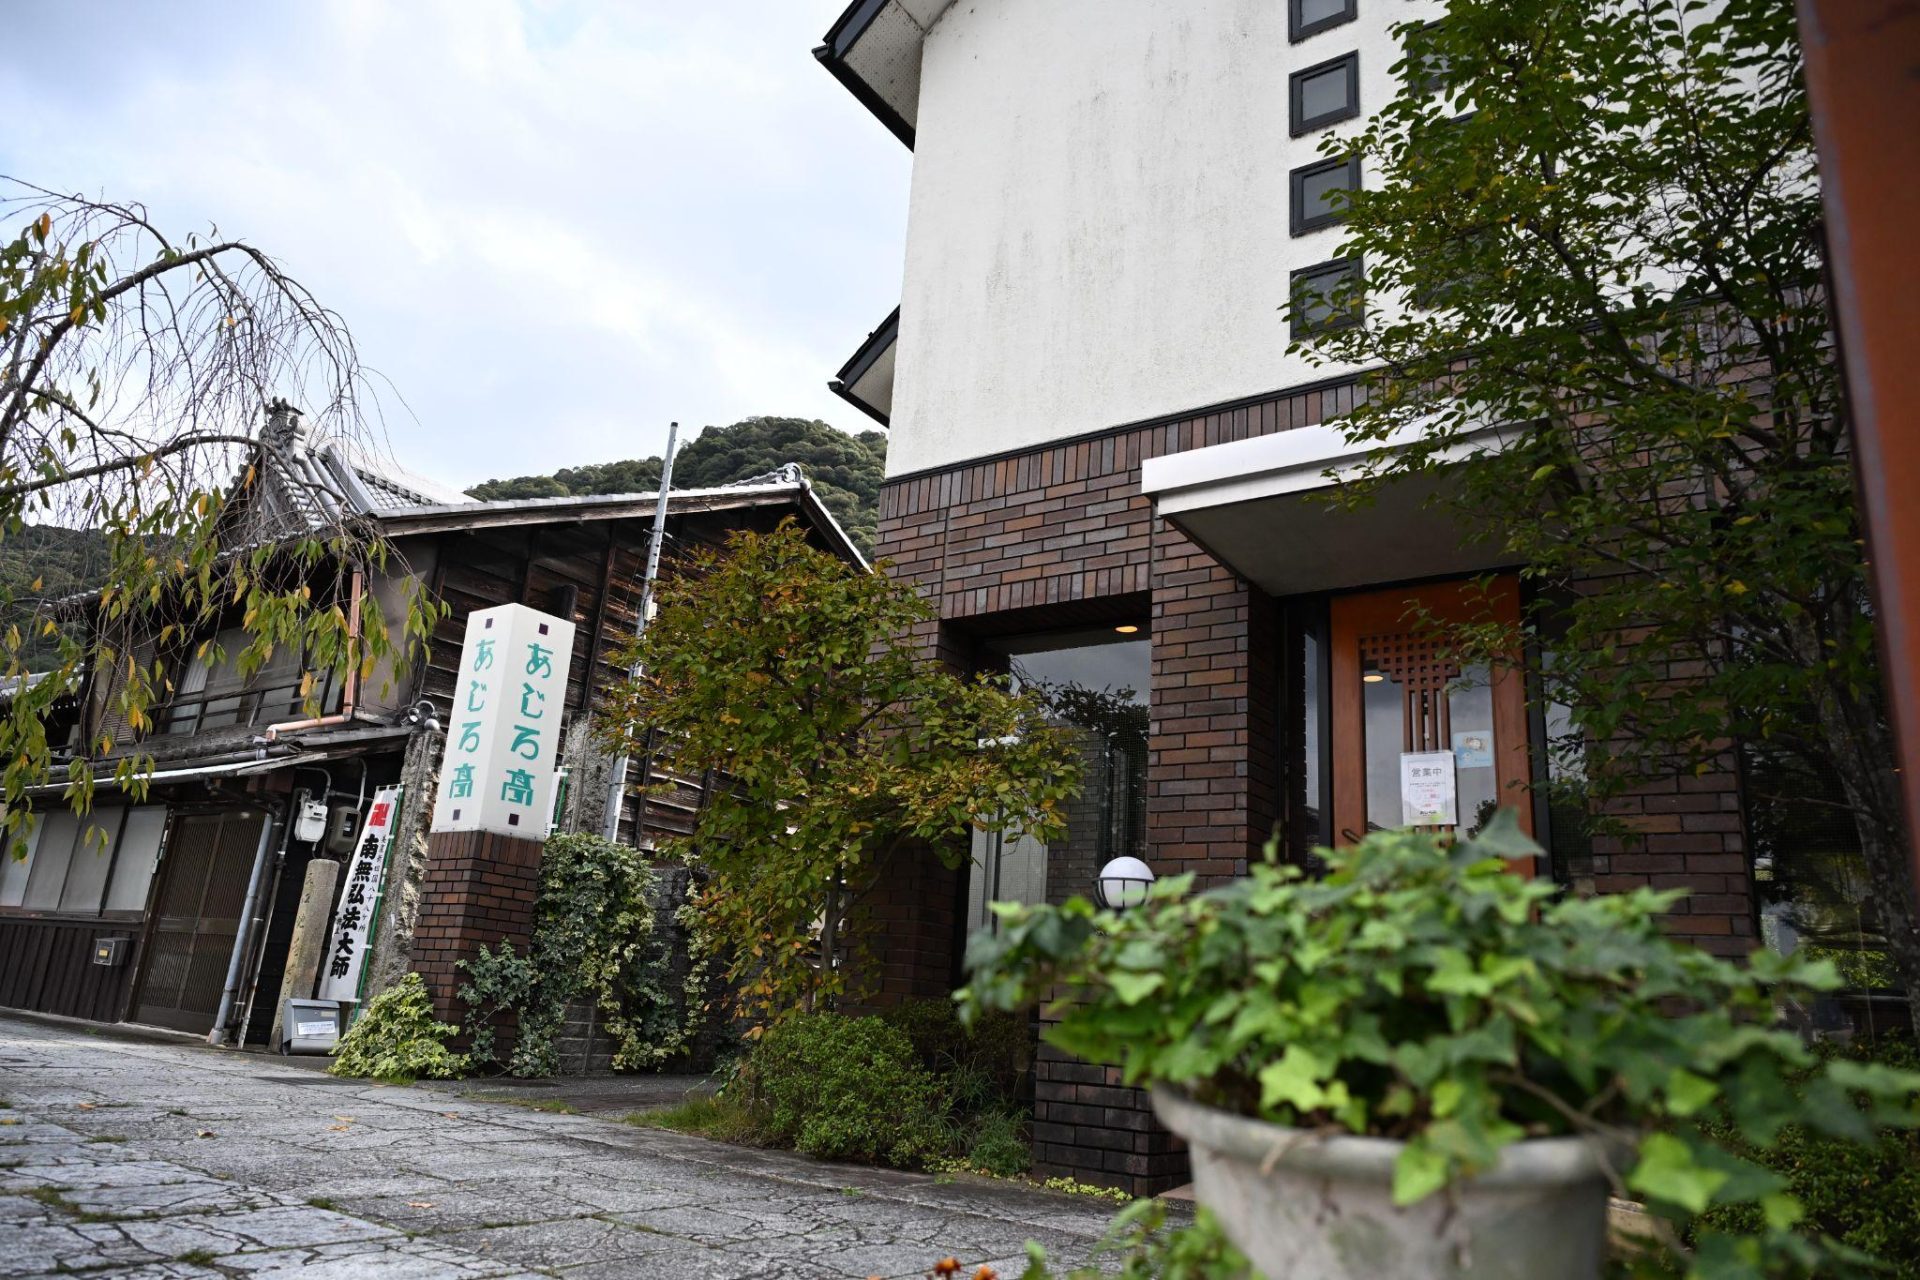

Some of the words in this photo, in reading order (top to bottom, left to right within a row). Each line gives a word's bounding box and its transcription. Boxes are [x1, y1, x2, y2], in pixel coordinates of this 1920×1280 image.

[449, 639, 496, 799] あじろ亭
[501, 642, 554, 806] あじろ亭
[1411, 767, 1443, 778] 営業中
[330, 833, 379, 980] 南無弘法大師
